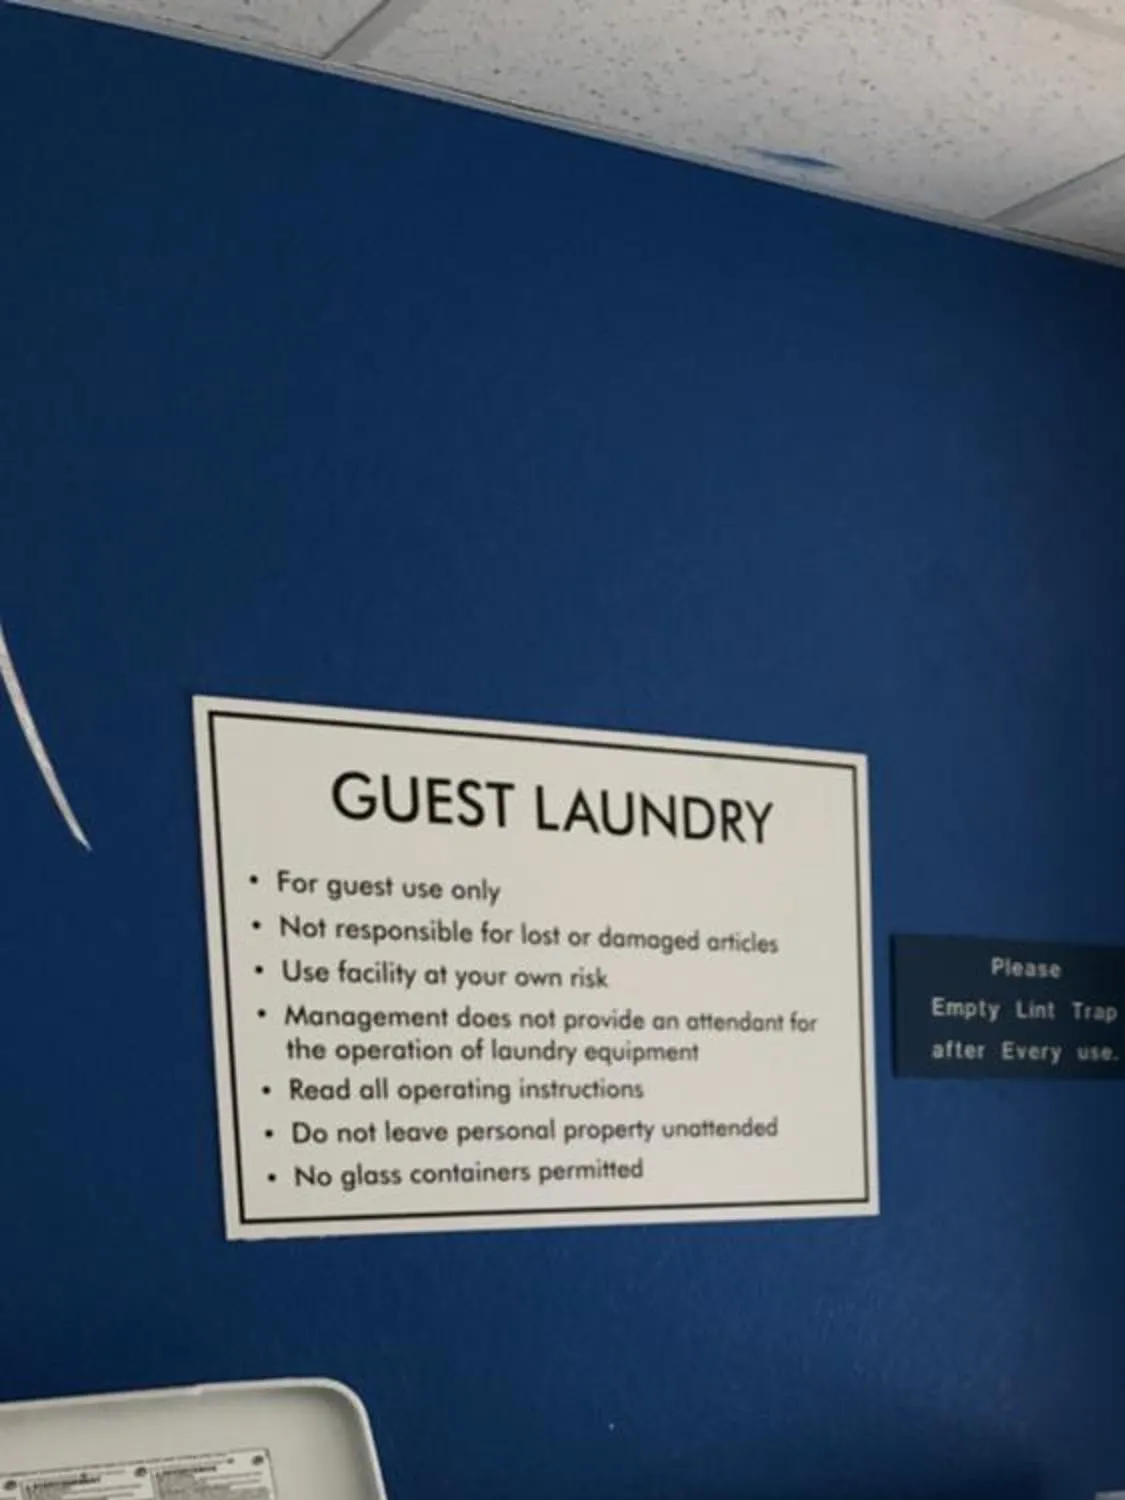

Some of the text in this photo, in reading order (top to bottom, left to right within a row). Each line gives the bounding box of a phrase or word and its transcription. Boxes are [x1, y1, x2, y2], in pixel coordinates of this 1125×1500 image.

[331, 770, 774, 845] GUEST LAUNDRY
[276, 869, 501, 908] For guest use only
[279, 914, 780, 956] Not responsible for lost or damaged articles
[281, 959, 609, 992] Use facility at your own risk
[991, 956, 1062, 979] Please
[284, 1004, 818, 1035] Management does not provide an attendant for
[931, 996, 1119, 1024] Empty Lint Trap
[285, 1036, 700, 1067] the operation of laundry equipment
[931, 1040, 1120, 1065] after Every use.
[289, 1076, 645, 1106] Read all operating instructions
[291, 1116, 779, 1148] Do not leave personal property unattended
[294, 1157, 644, 1193] No glass containers permitted
